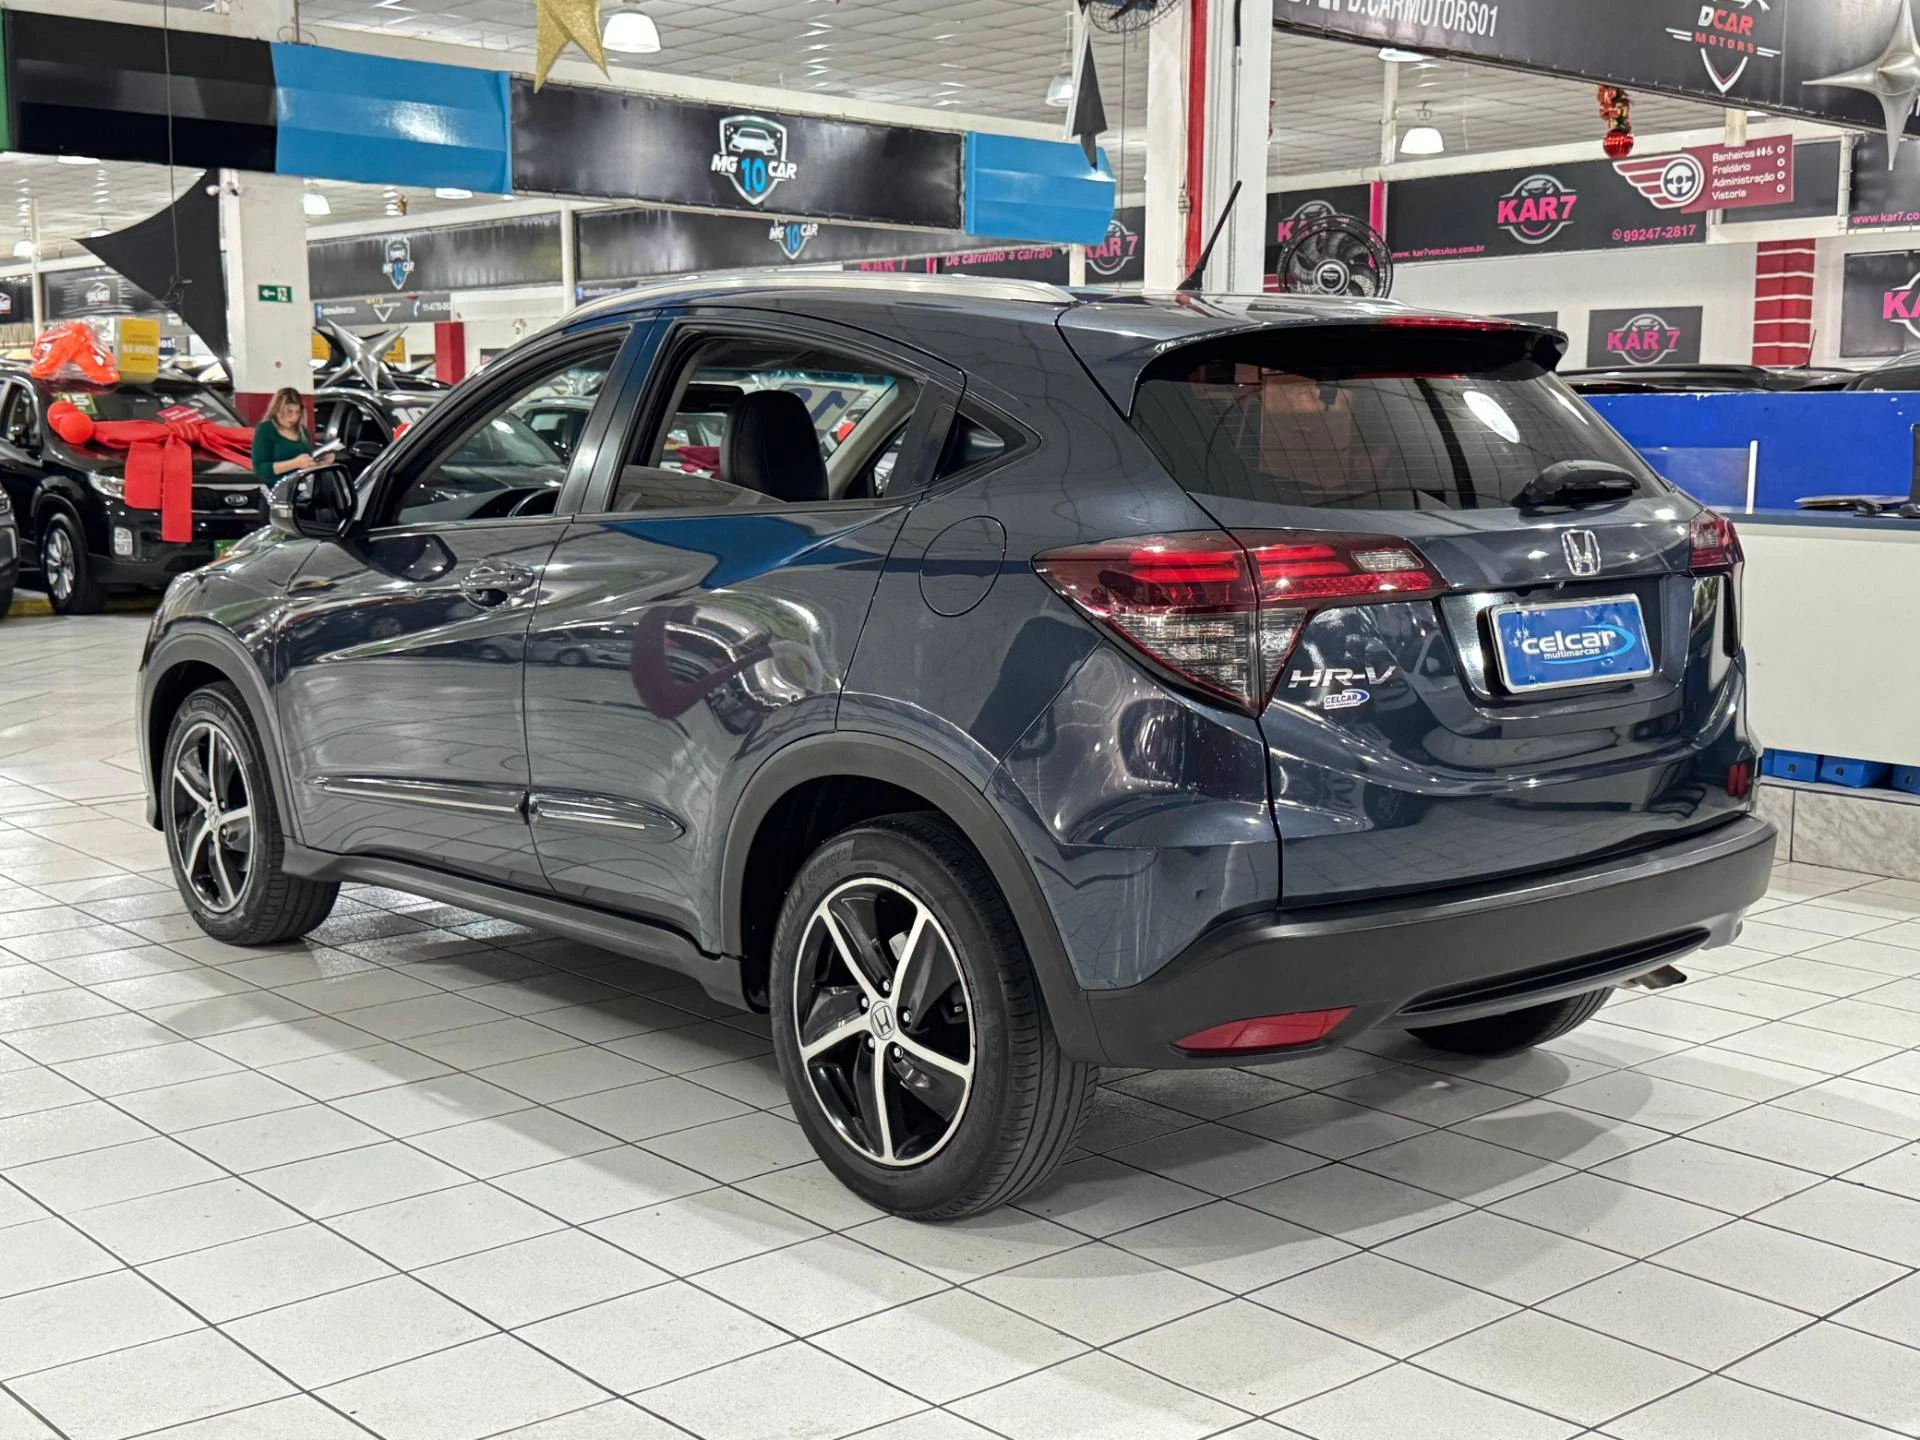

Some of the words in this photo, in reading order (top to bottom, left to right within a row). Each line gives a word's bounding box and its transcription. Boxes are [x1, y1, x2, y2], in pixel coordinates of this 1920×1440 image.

[1698, 5, 1754, 36] DCAR
[1695, 32, 1755, 54] MOTORS
[1712, 150, 1756, 163] Banheiros
[711, 154, 738, 173] MG
[741, 158, 767, 193] 10
[768, 161, 797, 180] CAR
[1712, 163, 1752, 175] Fraldário
[1712, 172, 1776, 188] Administração
[1712, 189, 1747, 201] Vistoria
[1852, 212, 1920, 225] www.kar7.co
[785, 224, 800, 250] 10
[1623, 223, 1697, 243] 99247-2817
[1126, 235, 1138, 256] 7
[1607, 331, 1659, 352] KAR
[1666, 330, 1680, 349] 7
[1521, 630, 1617, 655] celcar
[1543, 647, 1600, 661] multimarcas
[1288, 665, 1397, 688] HR-V
[1325, 694, 1358, 704] CELCAR
